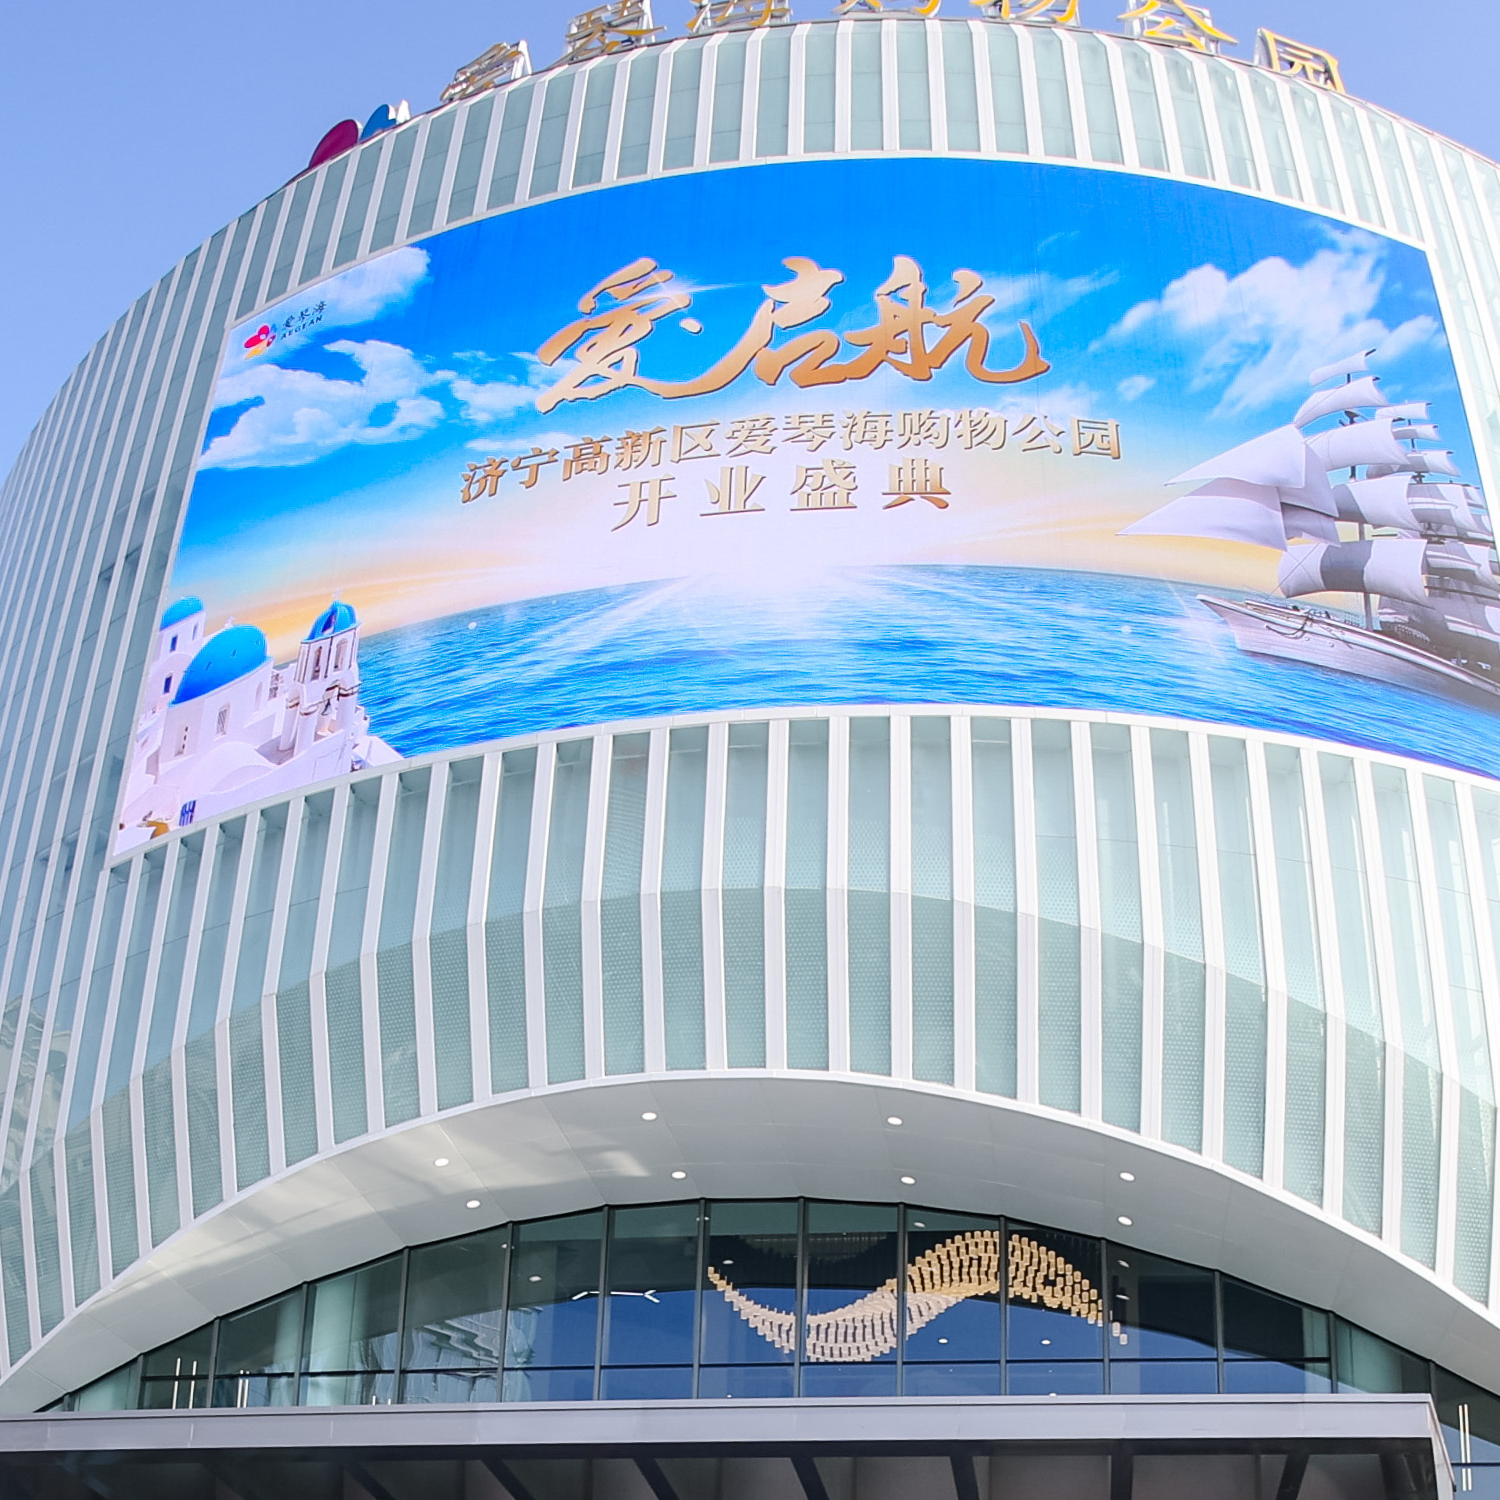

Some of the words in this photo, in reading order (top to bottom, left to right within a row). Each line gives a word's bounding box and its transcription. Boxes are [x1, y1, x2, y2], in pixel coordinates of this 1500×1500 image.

[280, 315, 324, 340] AEGEAN
[536, 253, 1050, 416] 爱启航
[460, 409, 1122, 504] 济宁高新区爱琴海购物公园
[611, 457, 952, 531] 开业盛典
